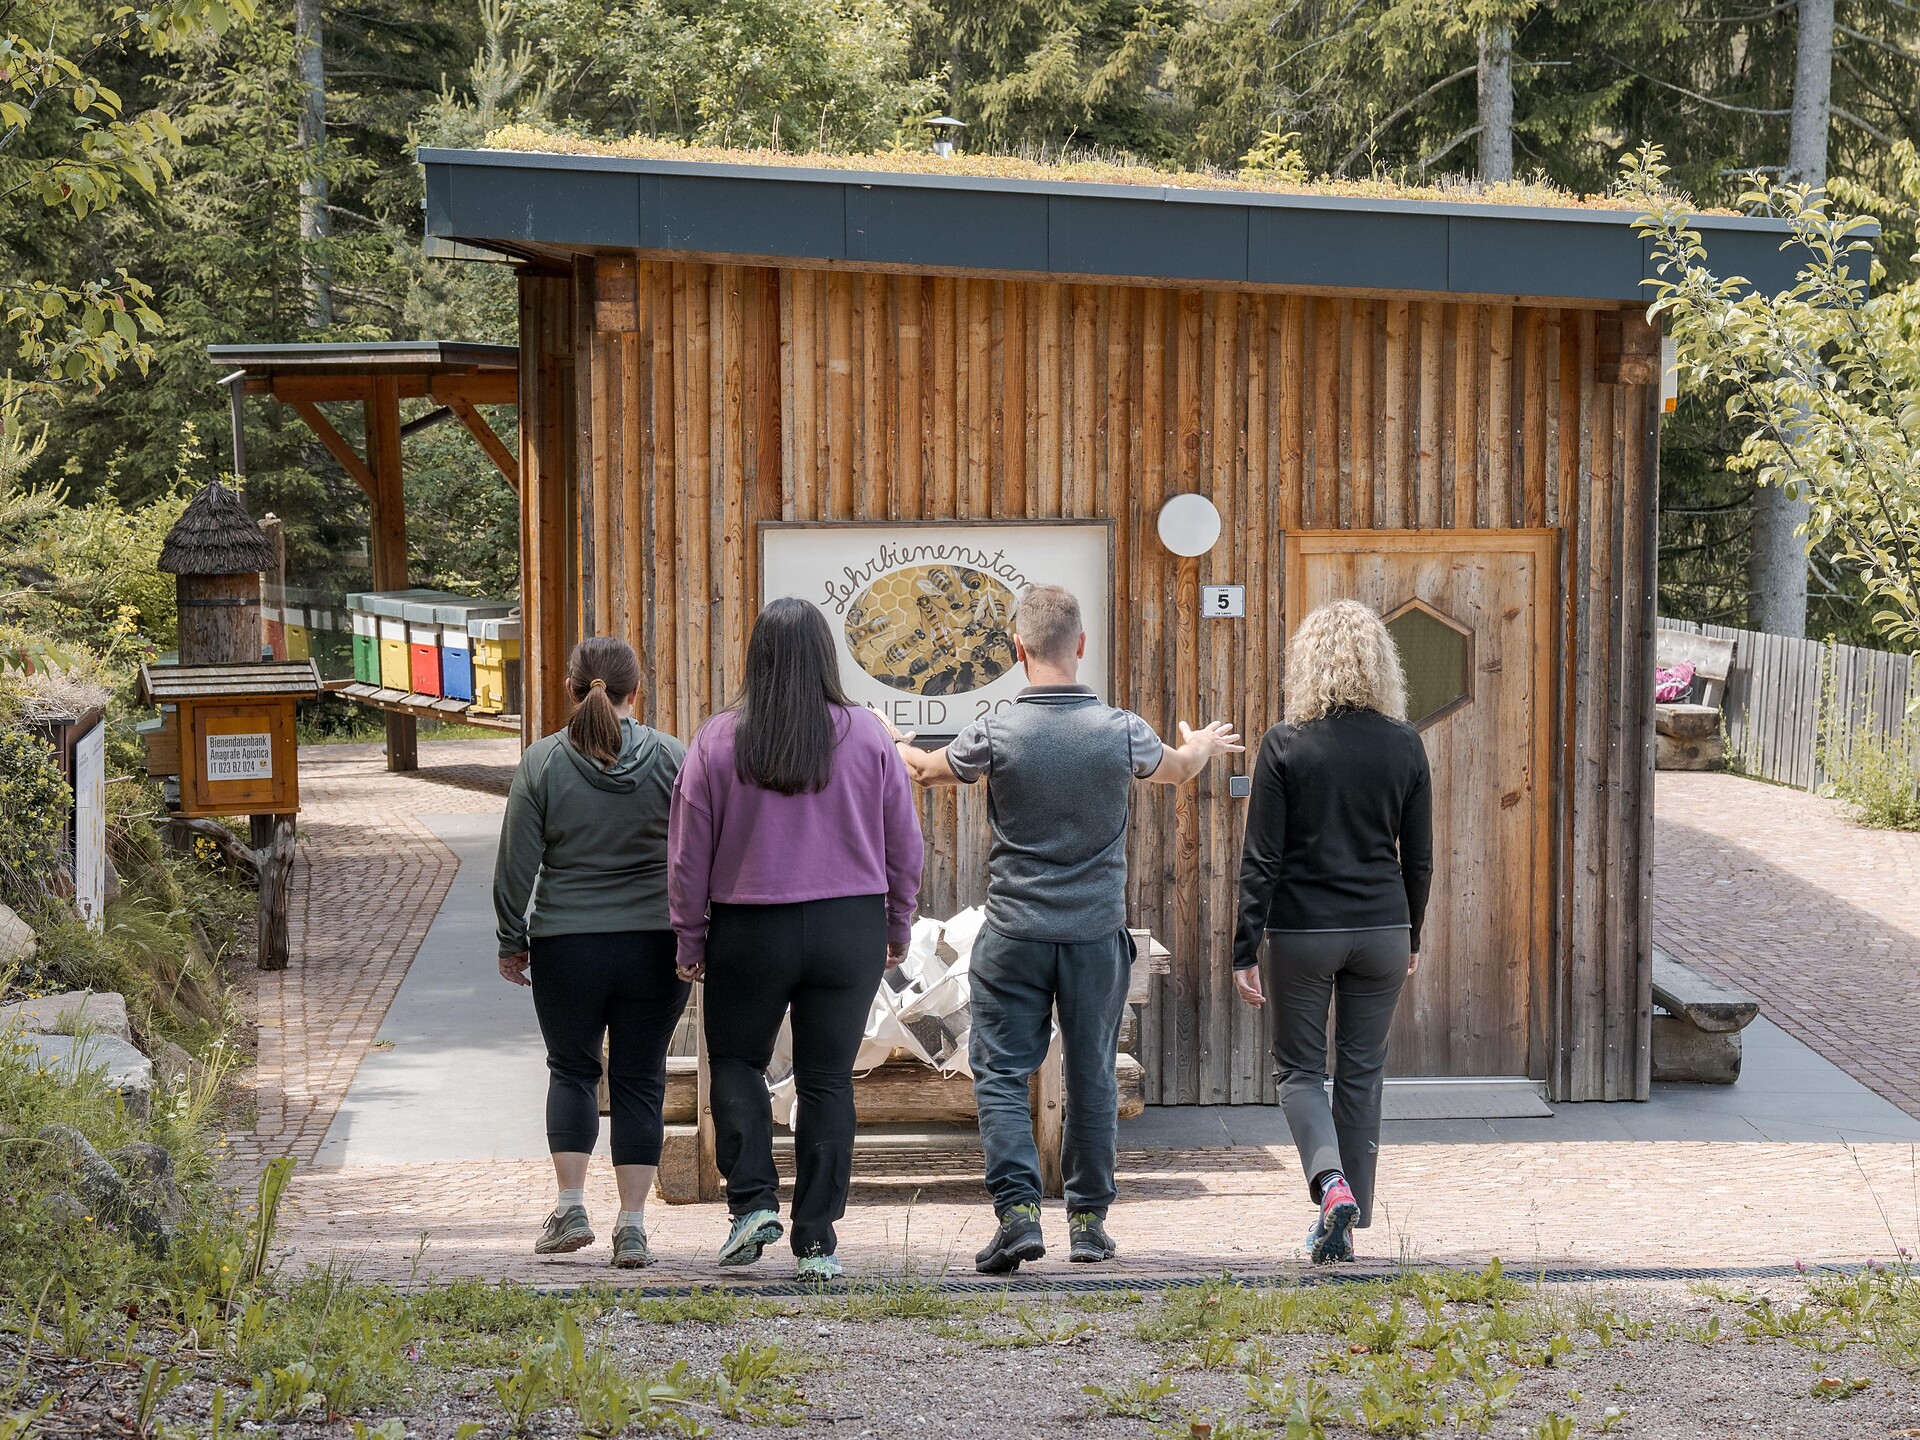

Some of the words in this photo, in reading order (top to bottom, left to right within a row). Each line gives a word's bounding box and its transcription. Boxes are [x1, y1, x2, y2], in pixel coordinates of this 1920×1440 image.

[1218, 594, 1229, 609] 5
[209, 735, 267, 748] Bienendatenbank
[210, 749, 240, 761] Anagrafe
[242, 747, 269, 760] Apistica
[210, 762, 217, 773] IT
[218, 762, 231, 773] 023
[232, 761, 241, 773] BZ
[243, 761, 255, 772] 024
